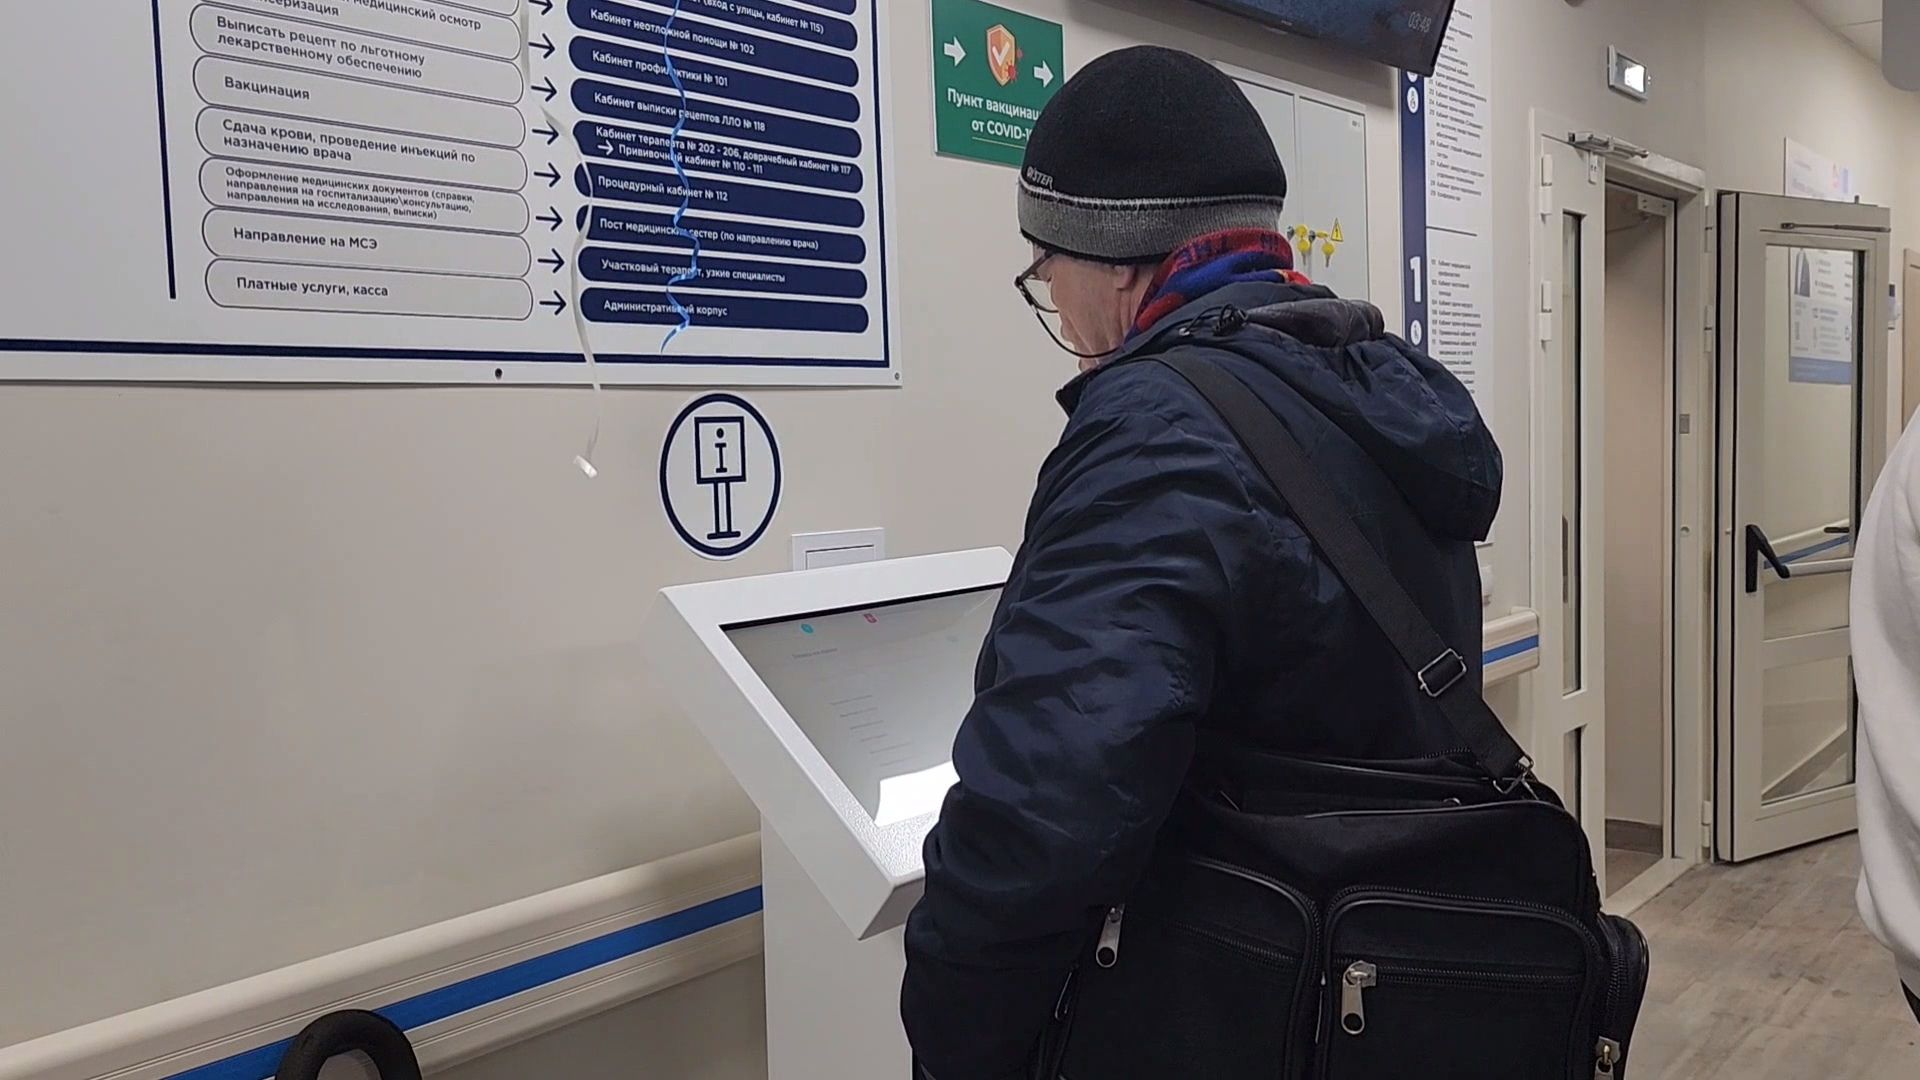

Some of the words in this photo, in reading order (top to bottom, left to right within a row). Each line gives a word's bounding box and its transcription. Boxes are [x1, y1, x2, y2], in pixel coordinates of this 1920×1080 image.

[440, 13, 481, 30] осмотр
[590, 8, 632, 26] Кабинет
[692, 34, 728, 48] помощи
[730, 42, 738, 51] №
[740, 42, 754, 55] 102
[730, 4, 734, 12] с
[736, 6, 765, 20] улицы,
[766, 12, 798, 28] кабинет
[800, 20, 808, 29] №
[810, 22, 824, 34] 115)
[216, 16, 286, 38] Выписать
[290, 30, 337, 48] рецепт
[341, 42, 357, 52] по
[360, 44, 425, 66] льготному
[218, 34, 333, 64] лекарственному
[337, 55, 422, 78] обеспечению
[592, 50, 633, 68] Кабинет
[704, 73, 712, 82] №
[715, 76, 728, 86] 101
[224, 76, 310, 100] Вакцинация
[948, 88, 984, 108] Пункт
[594, 92, 634, 109] Кабинет
[638, 102, 676, 116] выписки
[722, 115, 741, 128] ЛЛО
[744, 120, 752, 128] №
[754, 121, 766, 132] 118
[223, 118, 266, 136] Сдача
[271, 127, 316, 144] крови,
[320, 133, 397, 152] проведение
[400, 141, 458, 162] инъекций
[461, 152, 475, 162] по
[972, 120, 984, 132] от
[986, 120, 1032, 141] COVID-1
[224, 136, 309, 156] назначению
[314, 147, 352, 161] врача
[596, 126, 636, 142] Кабинет
[686, 140, 696, 150] №
[698, 143, 714, 154] 202
[723, 146, 742, 159] 206,
[743, 150, 797, 167] доврачебный
[800, 160, 830, 173] кабинет
[840, 165, 852, 175] 117
[684, 155, 720, 168] кабинет
[722, 160, 731, 169] №
[732, 162, 746, 172] 110
[753, 164, 763, 174] 111
[226, 166, 299, 183] Оформление
[302, 177, 370, 192] медицинских
[372, 184, 429, 198] документов
[226, 179, 298, 194] направления
[302, 188, 314, 196] на
[598, 176, 664, 192] Процедурный
[666, 186, 702, 198] кабинет
[705, 191, 714, 200] №
[716, 192, 728, 201] 112
[227, 191, 299, 206] направления
[302, 199, 314, 208] на
[318, 200, 390, 216] исследования,
[394, 208, 438, 220] выписки)
[234, 227, 326, 246] Направление
[330, 238, 345, 247] на
[350, 237, 378, 250] МСЭ
[600, 218, 623, 230] Пост
[720, 231, 734, 241] (по
[736, 234, 792, 247] направлению
[793, 238, 818, 250] врача)
[602, 258, 658, 273] Участковый
[706, 270, 730, 279] узкие
[732, 270, 786, 282] специалисты
[1409, 256, 1422, 303] 1
[236, 276, 297, 292] Платные
[302, 282, 350, 296] услуги,
[353, 286, 388, 296] касса
[696, 306, 728, 317] корпус
